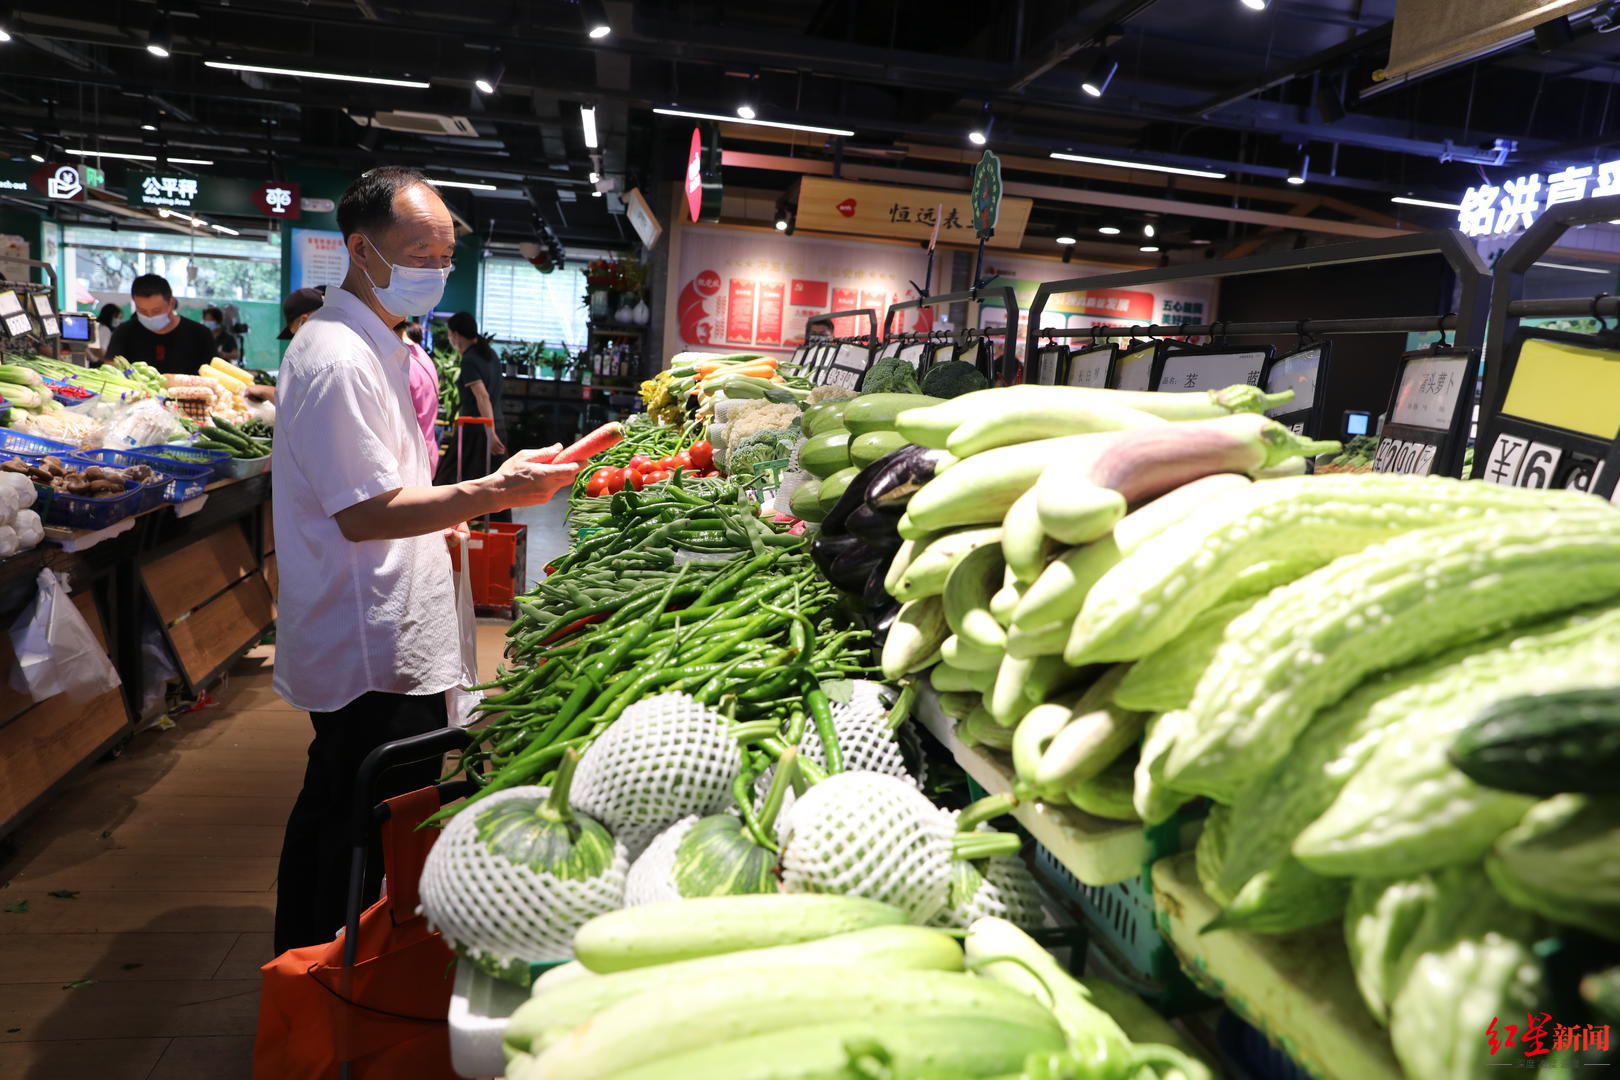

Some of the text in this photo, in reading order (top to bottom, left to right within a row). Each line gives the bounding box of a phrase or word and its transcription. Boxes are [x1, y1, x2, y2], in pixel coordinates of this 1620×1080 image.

[142, 176, 198, 199] 公平秤
[889, 204, 973, 229] 恒远表
